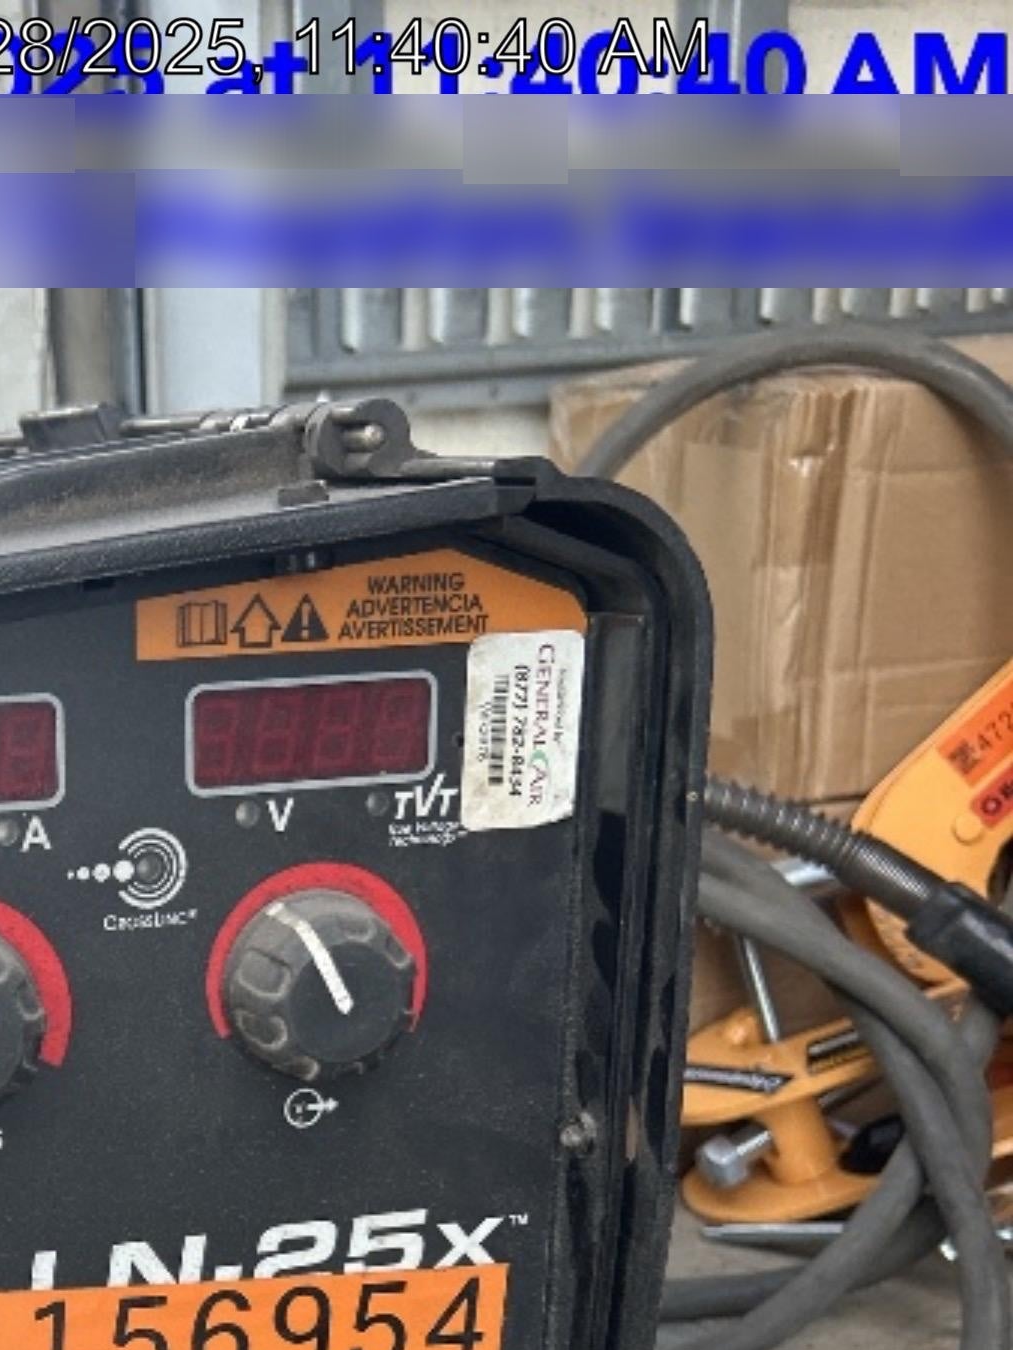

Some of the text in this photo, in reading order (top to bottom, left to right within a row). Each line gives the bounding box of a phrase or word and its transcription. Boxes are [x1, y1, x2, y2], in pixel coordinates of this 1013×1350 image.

[368, 572, 465, 595] WARNING
[346, 593, 484, 618] ADVERTENCIA
[338, 614, 489, 640] AVERTISSEMENT
[512, 664, 531, 710] (877)
[266, 798, 295, 833] V
[21, 817, 52, 851] A
